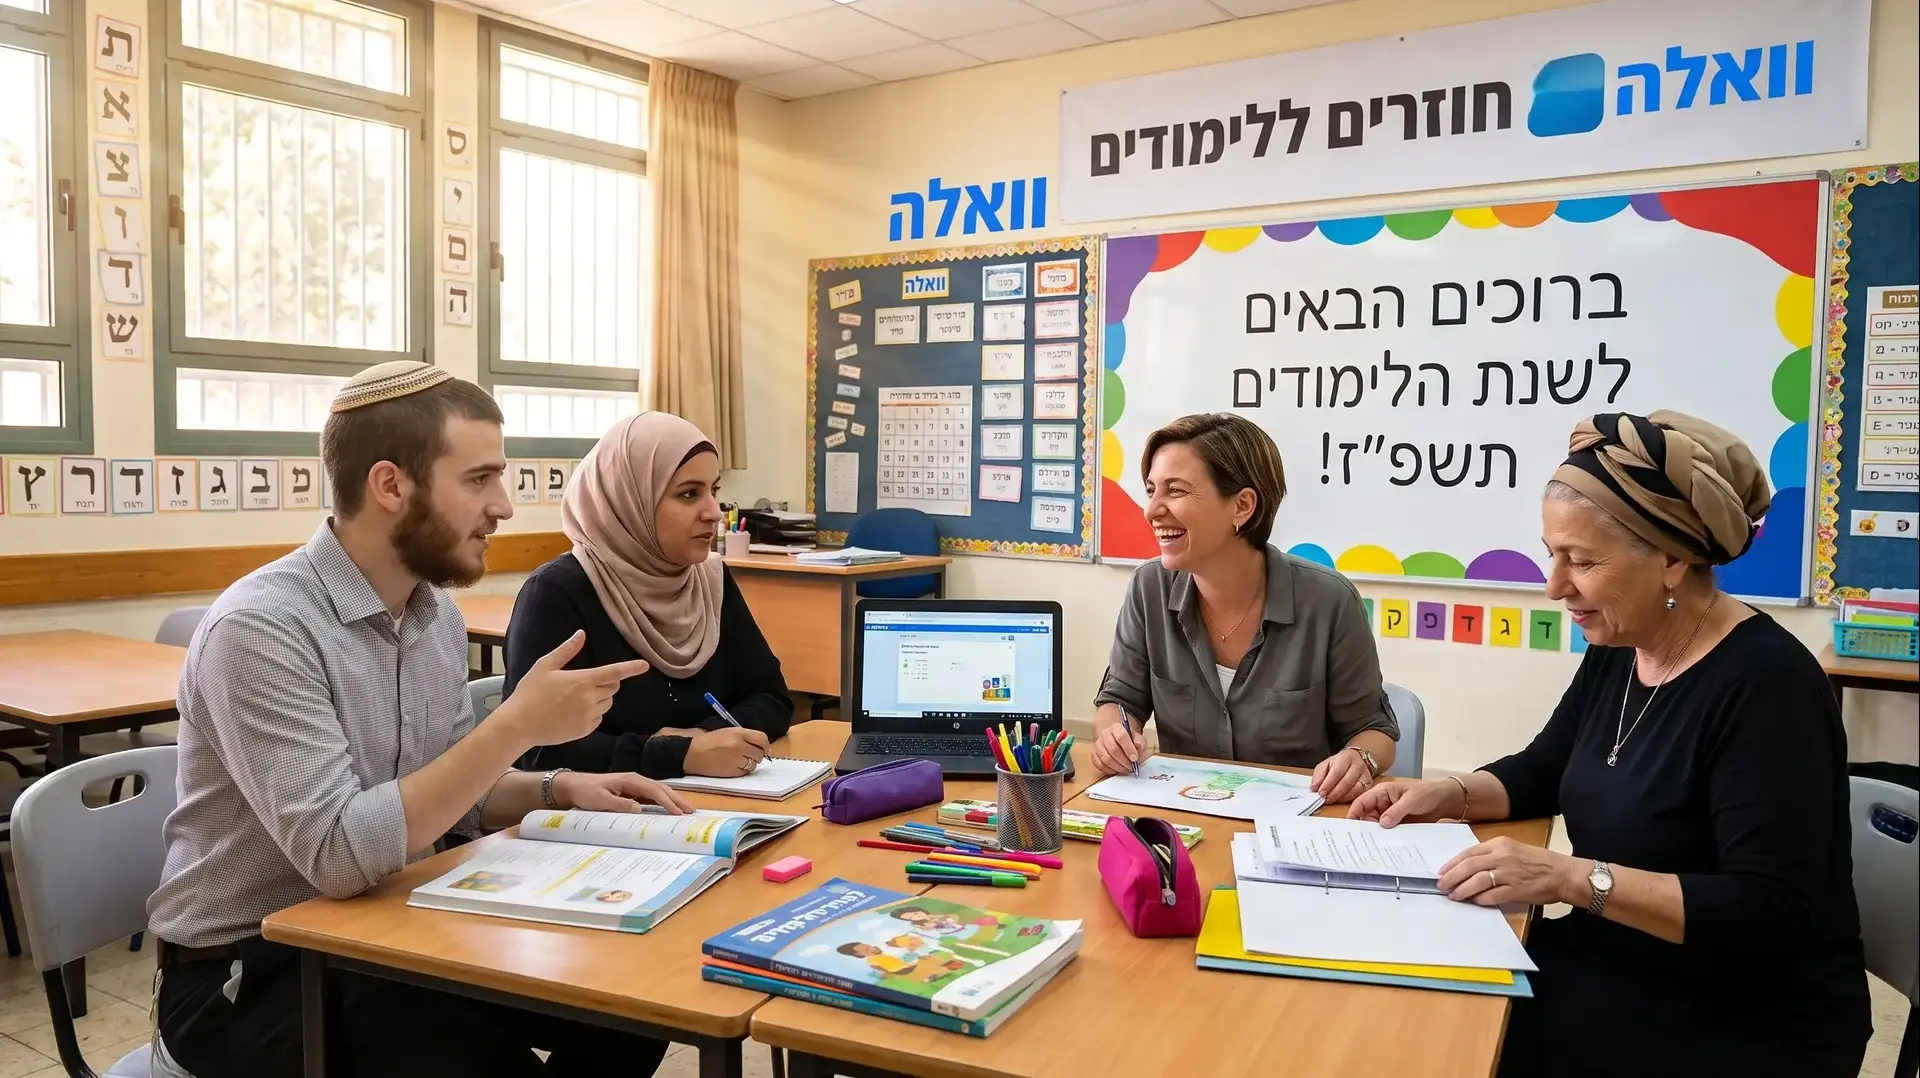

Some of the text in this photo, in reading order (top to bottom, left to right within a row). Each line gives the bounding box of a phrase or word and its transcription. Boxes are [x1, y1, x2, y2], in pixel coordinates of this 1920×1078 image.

[101, 25, 133, 63] ת
[101, 87, 131, 123] א
[1090, 39, 1815, 177] וואלה חוזרים ללימודים
[446, 127, 467, 155] ס
[106, 149, 130, 182] צ
[889, 176, 1047, 242] וואלה
[447, 234, 467, 262] ם
[905, 276, 945, 293] וואלה
[449, 287, 468, 314] ה
[1246, 272, 1628, 334] ברוכים הבאים
[106, 312, 139, 343] ש
[1233, 341, 1631, 409] לשנת הלימודים
[18, 465, 47, 502] ץ
[70, 465, 95, 496] ר
[119, 466, 144, 496] ד
[171, 465, 185, 496] ז
[210, 466, 226, 494] ג
[250, 465, 271, 494] ב
[291, 466, 311, 493] מ
[518, 467, 536, 490] ת
[548, 467, 563, 489] פ
[1387, 609, 1402, 630] ק
[1423, 612, 1438, 629] פ
[1460, 615, 1475, 633] ד
[1500, 618, 1511, 636] ג
[1537, 621, 1553, 639] ד
